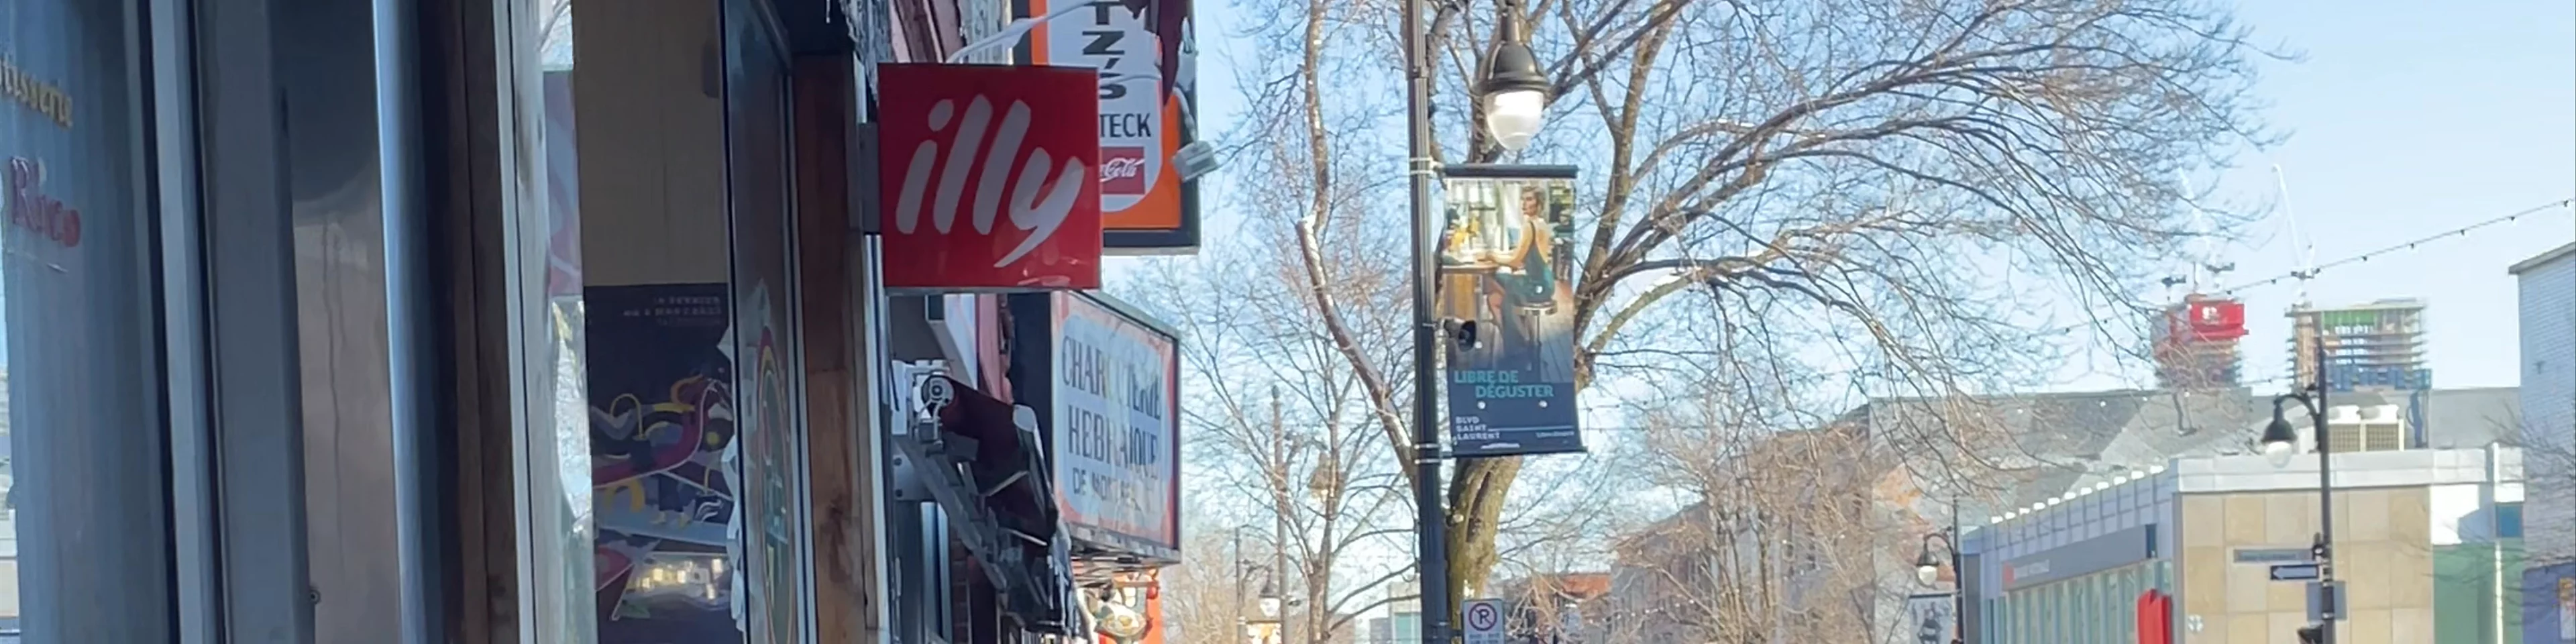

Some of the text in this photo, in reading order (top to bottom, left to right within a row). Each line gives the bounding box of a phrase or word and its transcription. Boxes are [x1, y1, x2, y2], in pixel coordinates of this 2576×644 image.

[896, 94, 1085, 268] illy
[1454, 370, 1519, 384] LIBRE DE
[1476, 382, 1554, 398] DÉGUSTER
[1456, 416, 1480, 424] BLVD
[1456, 424, 1487, 433] SAINT
[1457, 431, 1501, 441] LAURENT
